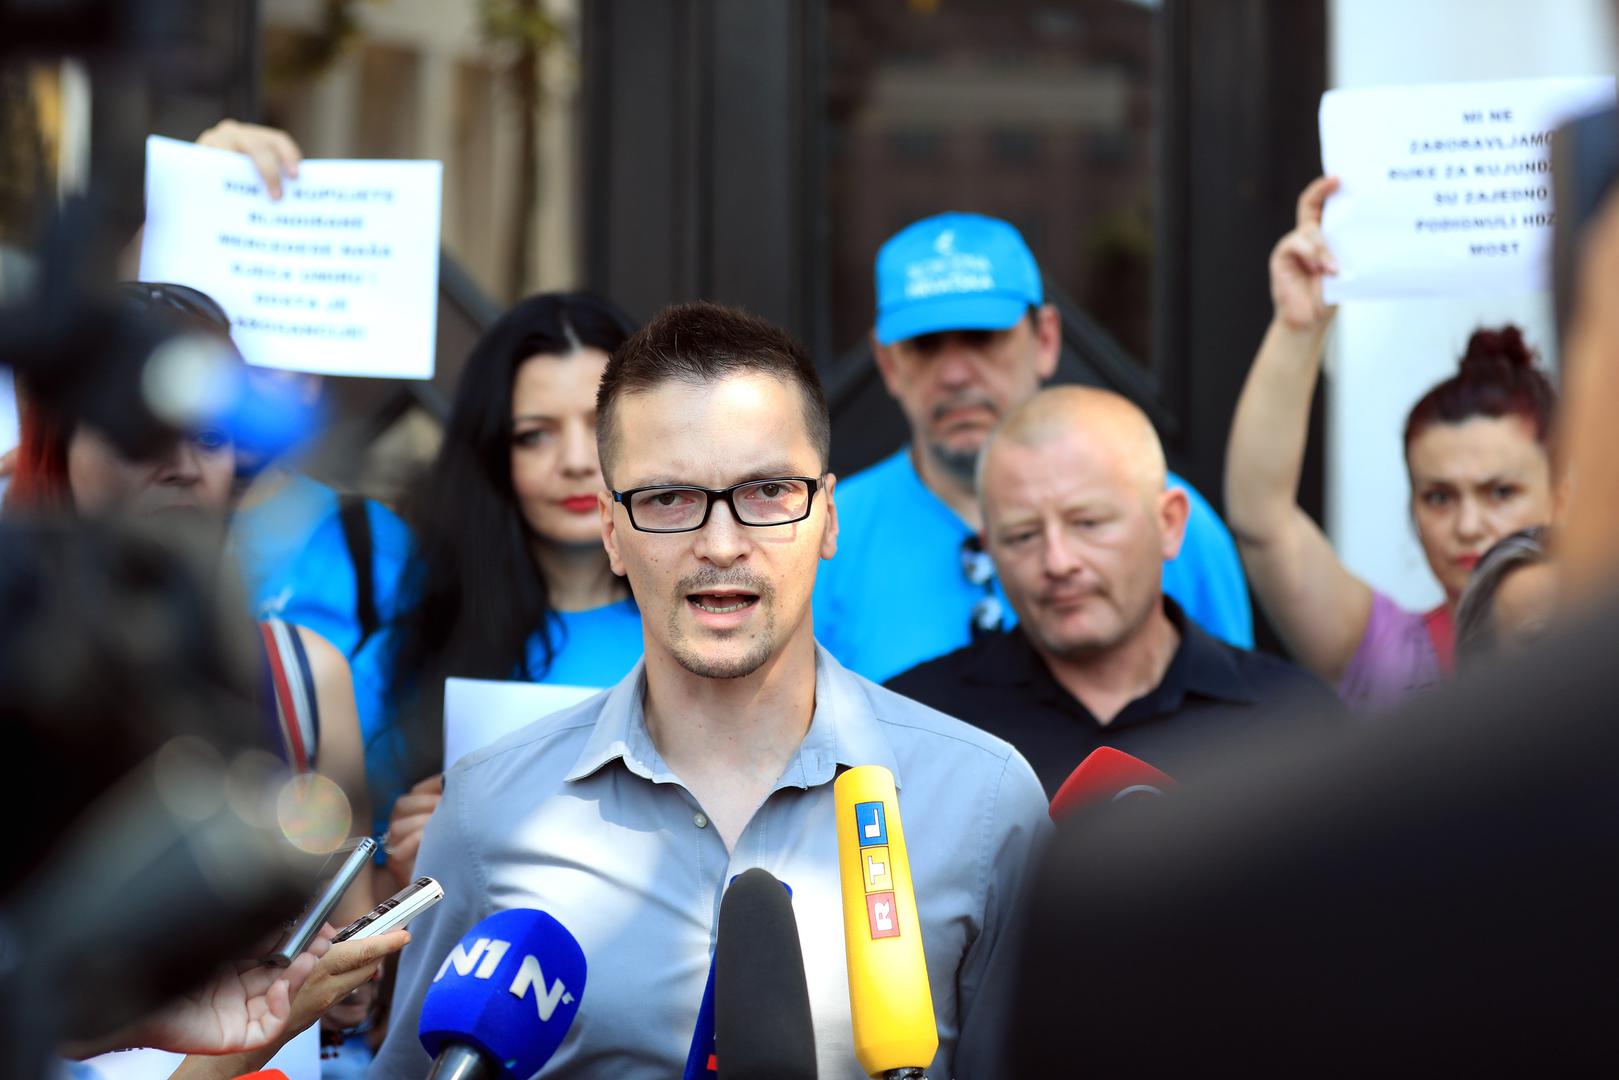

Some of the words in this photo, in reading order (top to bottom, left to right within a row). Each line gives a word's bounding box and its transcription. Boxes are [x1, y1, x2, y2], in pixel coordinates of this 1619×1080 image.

[1489, 108, 1513, 120] NE
[1469, 243, 1519, 256] MOST
[864, 807, 893, 931] RTL
[433, 938, 512, 983] N1
